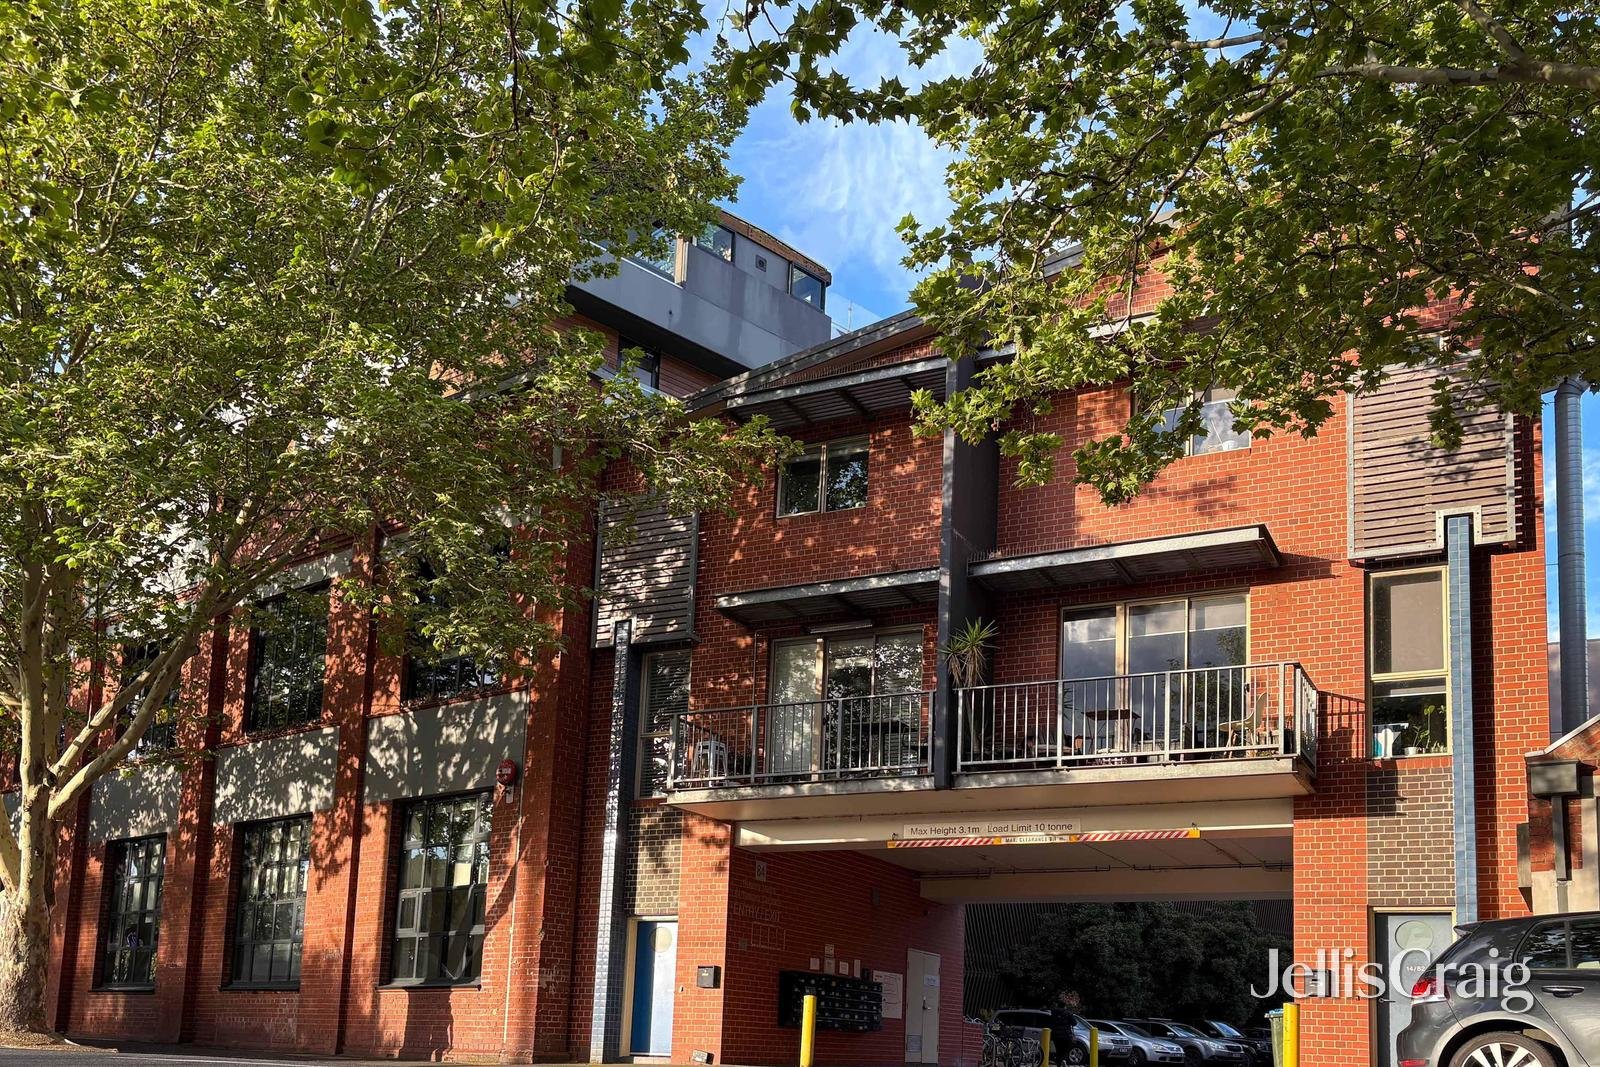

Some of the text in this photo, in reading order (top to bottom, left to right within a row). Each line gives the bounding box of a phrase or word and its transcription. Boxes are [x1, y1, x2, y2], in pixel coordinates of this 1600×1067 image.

[910, 822, 1073, 836] Max Height 3.1m Load Limit 10 tonne
